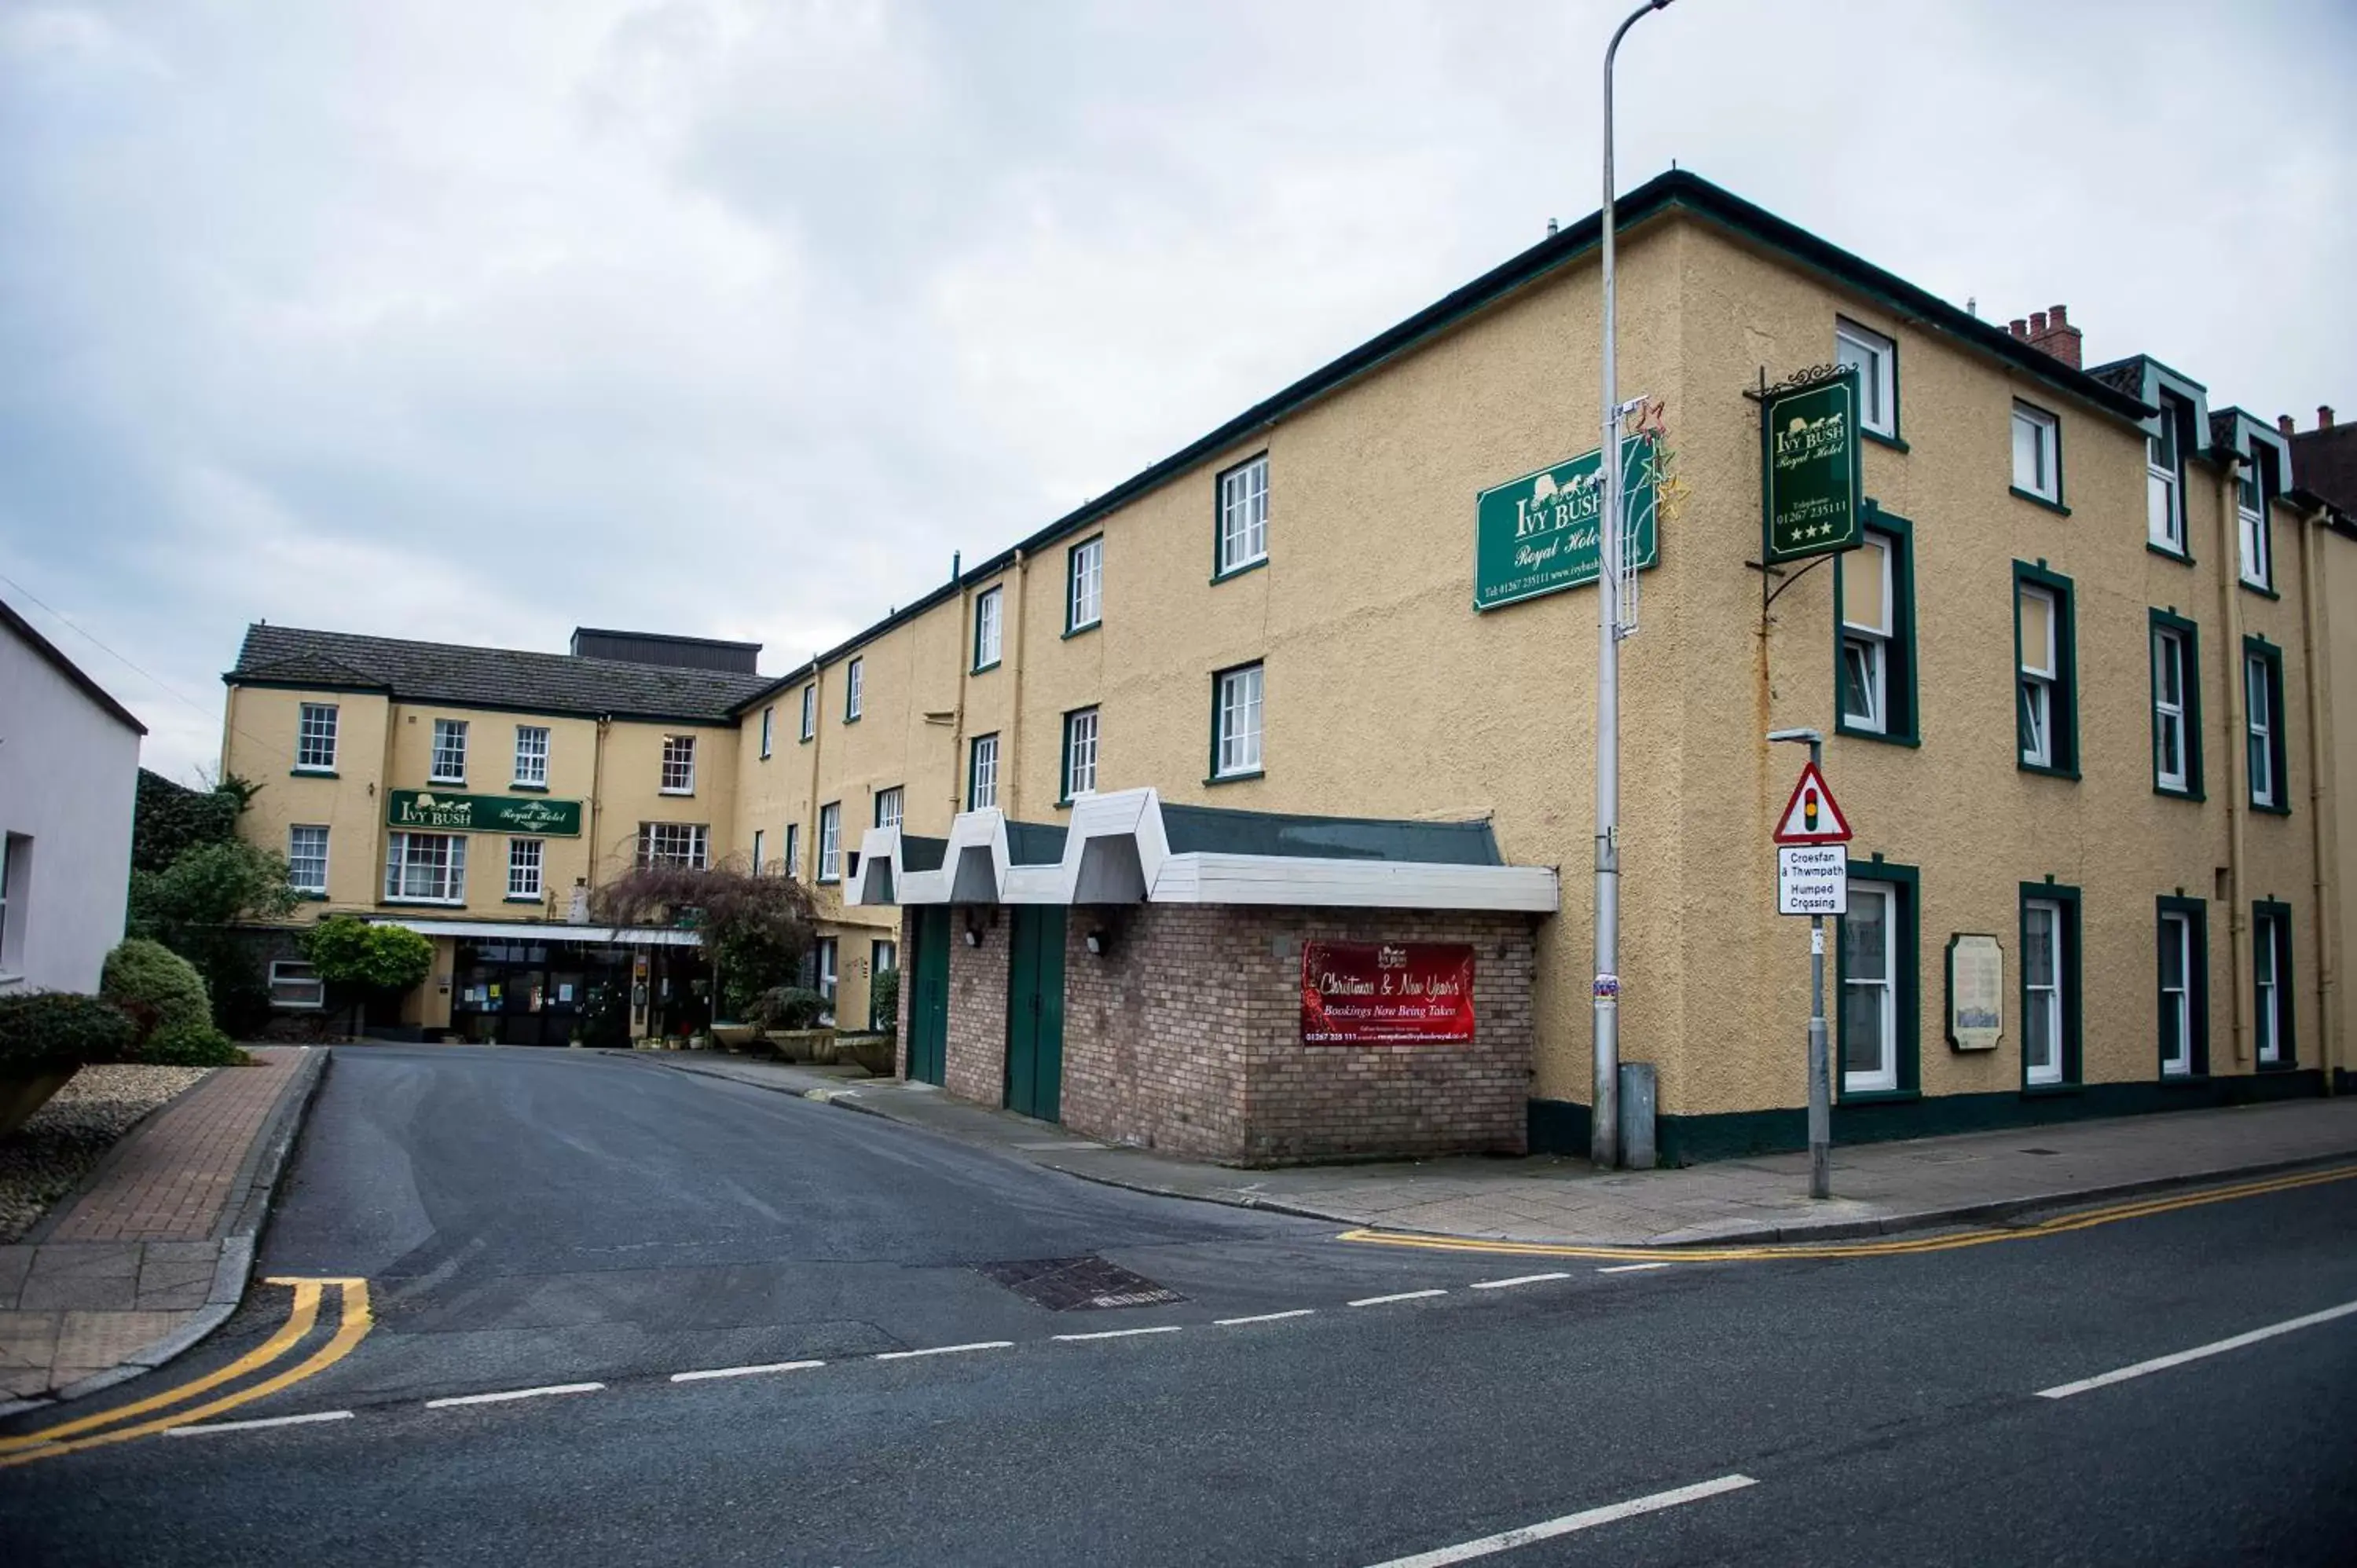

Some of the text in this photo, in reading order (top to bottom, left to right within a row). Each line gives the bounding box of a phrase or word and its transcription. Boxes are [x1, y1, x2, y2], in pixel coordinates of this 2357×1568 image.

[1776, 426, 1844, 453] IVY BUSH
[1776, 441, 1844, 470] Royal Hotel
[1515, 498, 1548, 537] IVY
[1776, 500, 1846, 526] 01267 235111
[1515, 538, 1559, 571] Royal
[1564, 527, 1601, 553] Hote
[400, 801, 471, 825] IVY BUSH
[499, 808, 566, 824] Royal Hotel
[1791, 852, 1835, 863] Croesfan
[1791, 866, 1844, 877] Thwmpath
[1791, 884, 1834, 896] Humped
[1791, 897, 1835, 910] Crossing
[1319, 972, 1374, 995] Christmas
[1380, 973, 1393, 995] &
[1398, 972, 1424, 995] New
[1323, 1005, 1456, 1019] Bookings Now Being Taken
